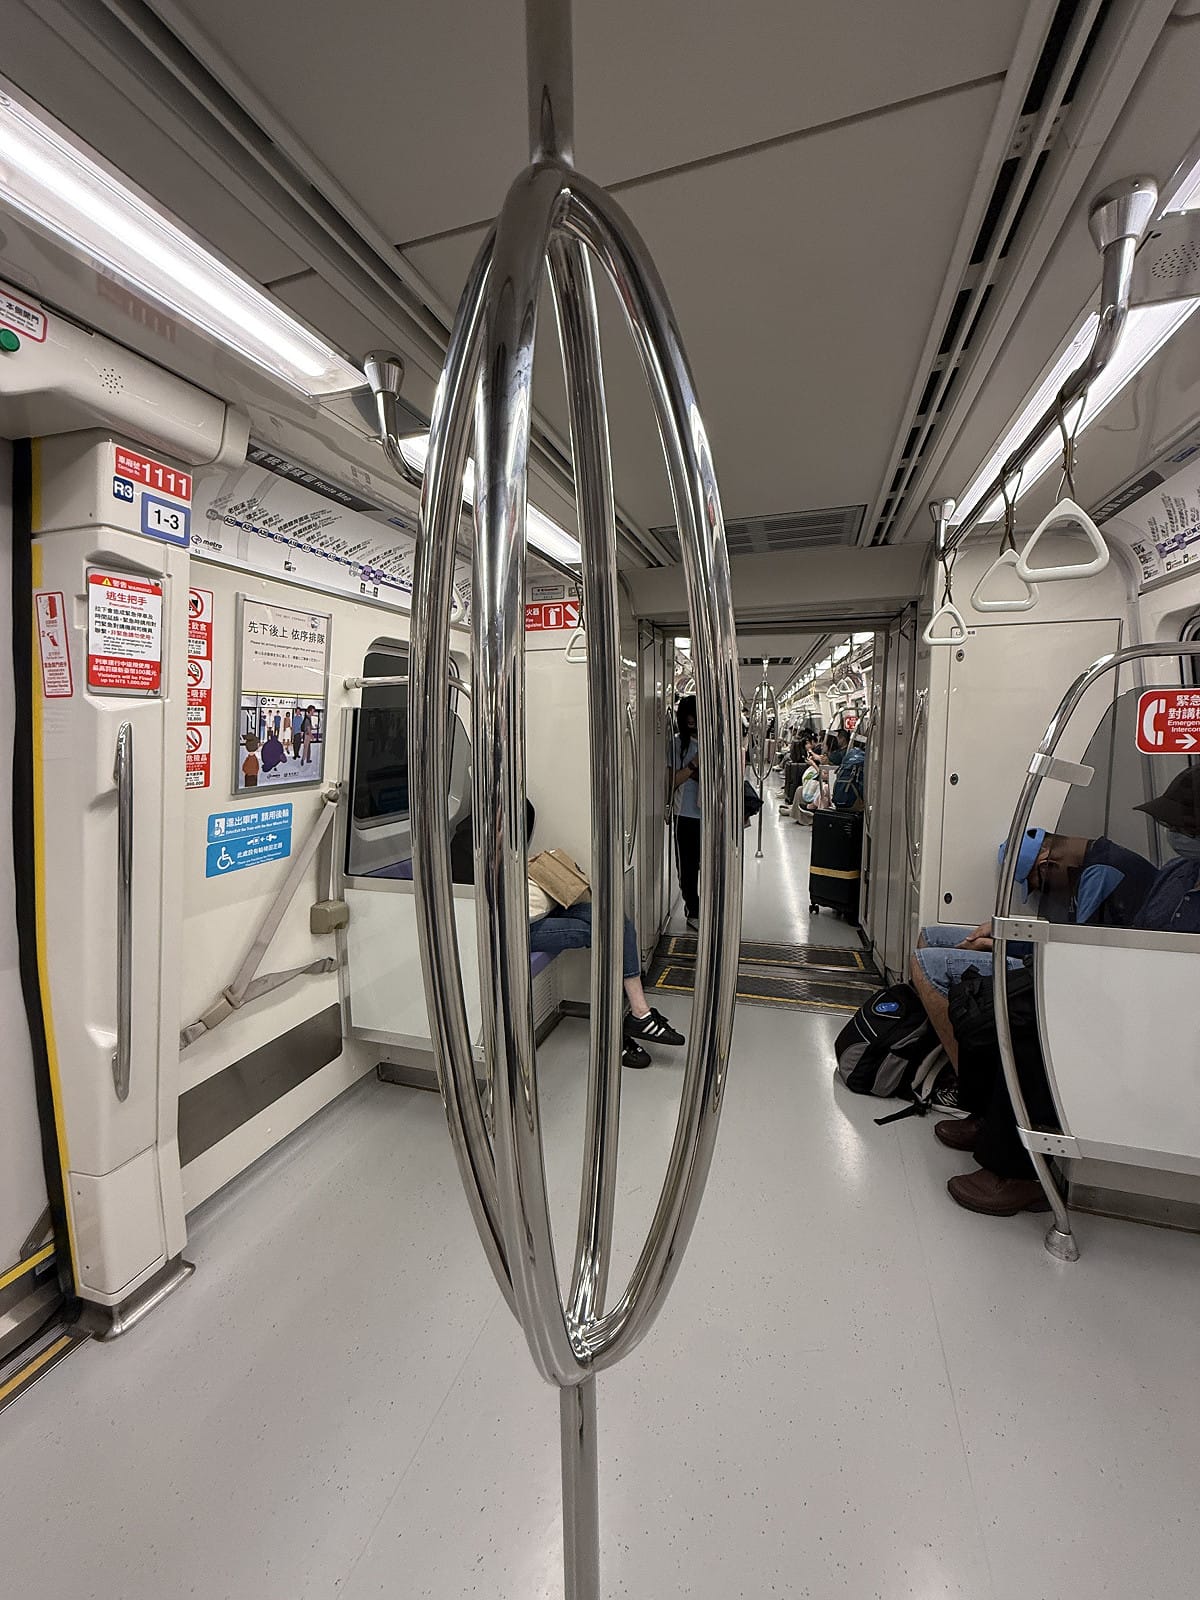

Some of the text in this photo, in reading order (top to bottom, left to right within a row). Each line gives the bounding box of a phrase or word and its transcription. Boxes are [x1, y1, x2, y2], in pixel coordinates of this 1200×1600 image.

[142, 463, 187, 497] 1111
[114, 482, 133, 499] R3
[154, 509, 180, 530] 1-3
[203, 539, 223, 549] metro
[105, 590, 148, 606] 逃生把手
[526, 607, 539, 616] 火器
[248, 620, 325, 645] 先下後上 依序排隊
[1176, 695, 1200, 706] 緊急
